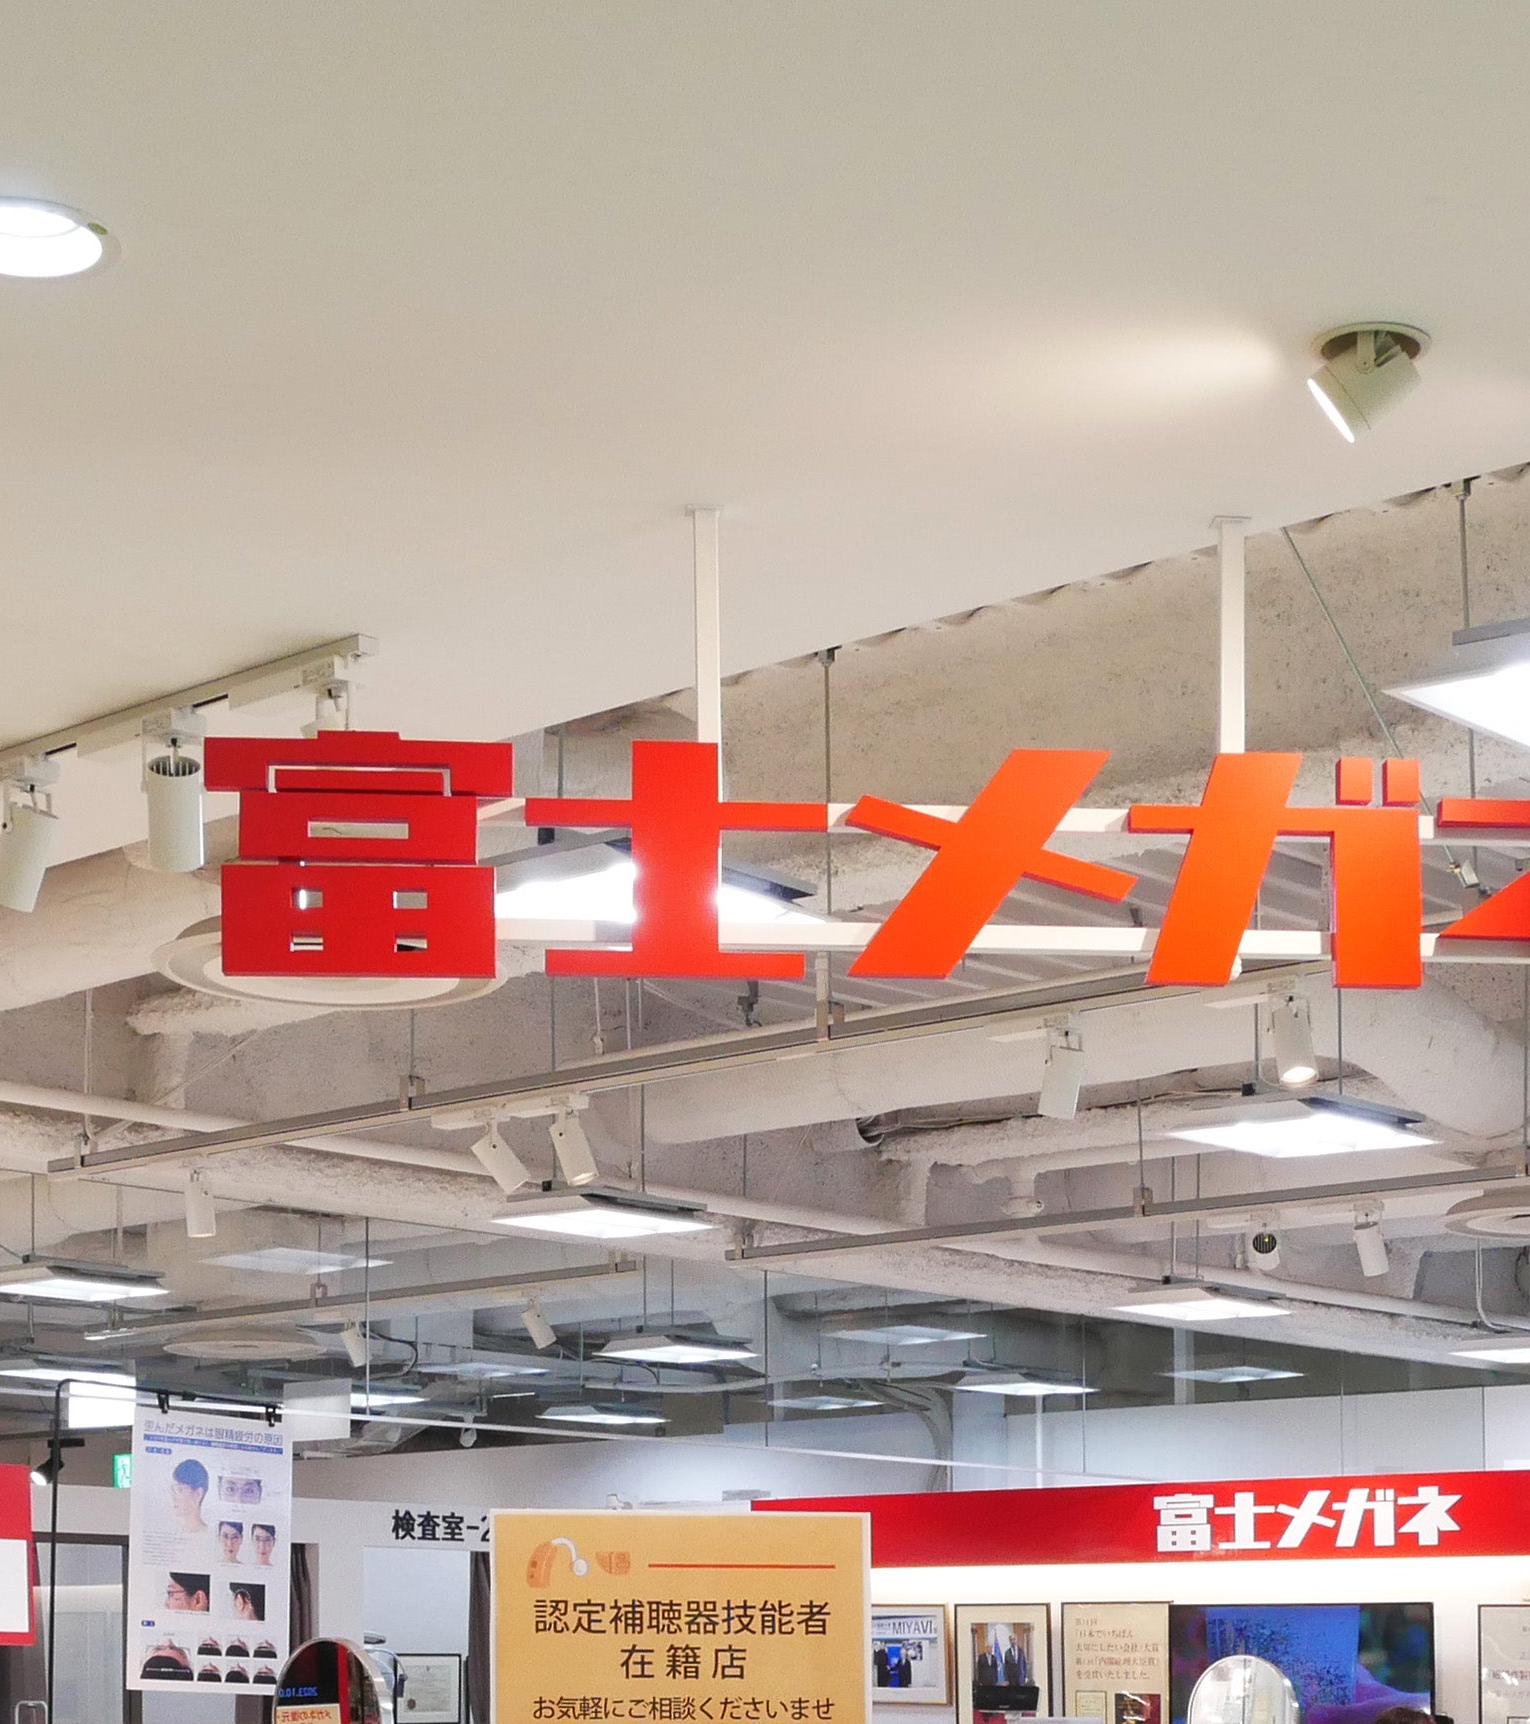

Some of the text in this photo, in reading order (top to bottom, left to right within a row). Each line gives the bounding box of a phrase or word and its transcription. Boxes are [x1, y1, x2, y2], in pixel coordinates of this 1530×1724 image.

[1153, 1486, 1462, 1552] 富士メガネ
[533, 1597, 832, 1637] 認定補聴器技能者
[619, 1643, 748, 1682] 在籍店
[532, 1695, 835, 1724] お気軽にご相談くださいませ
